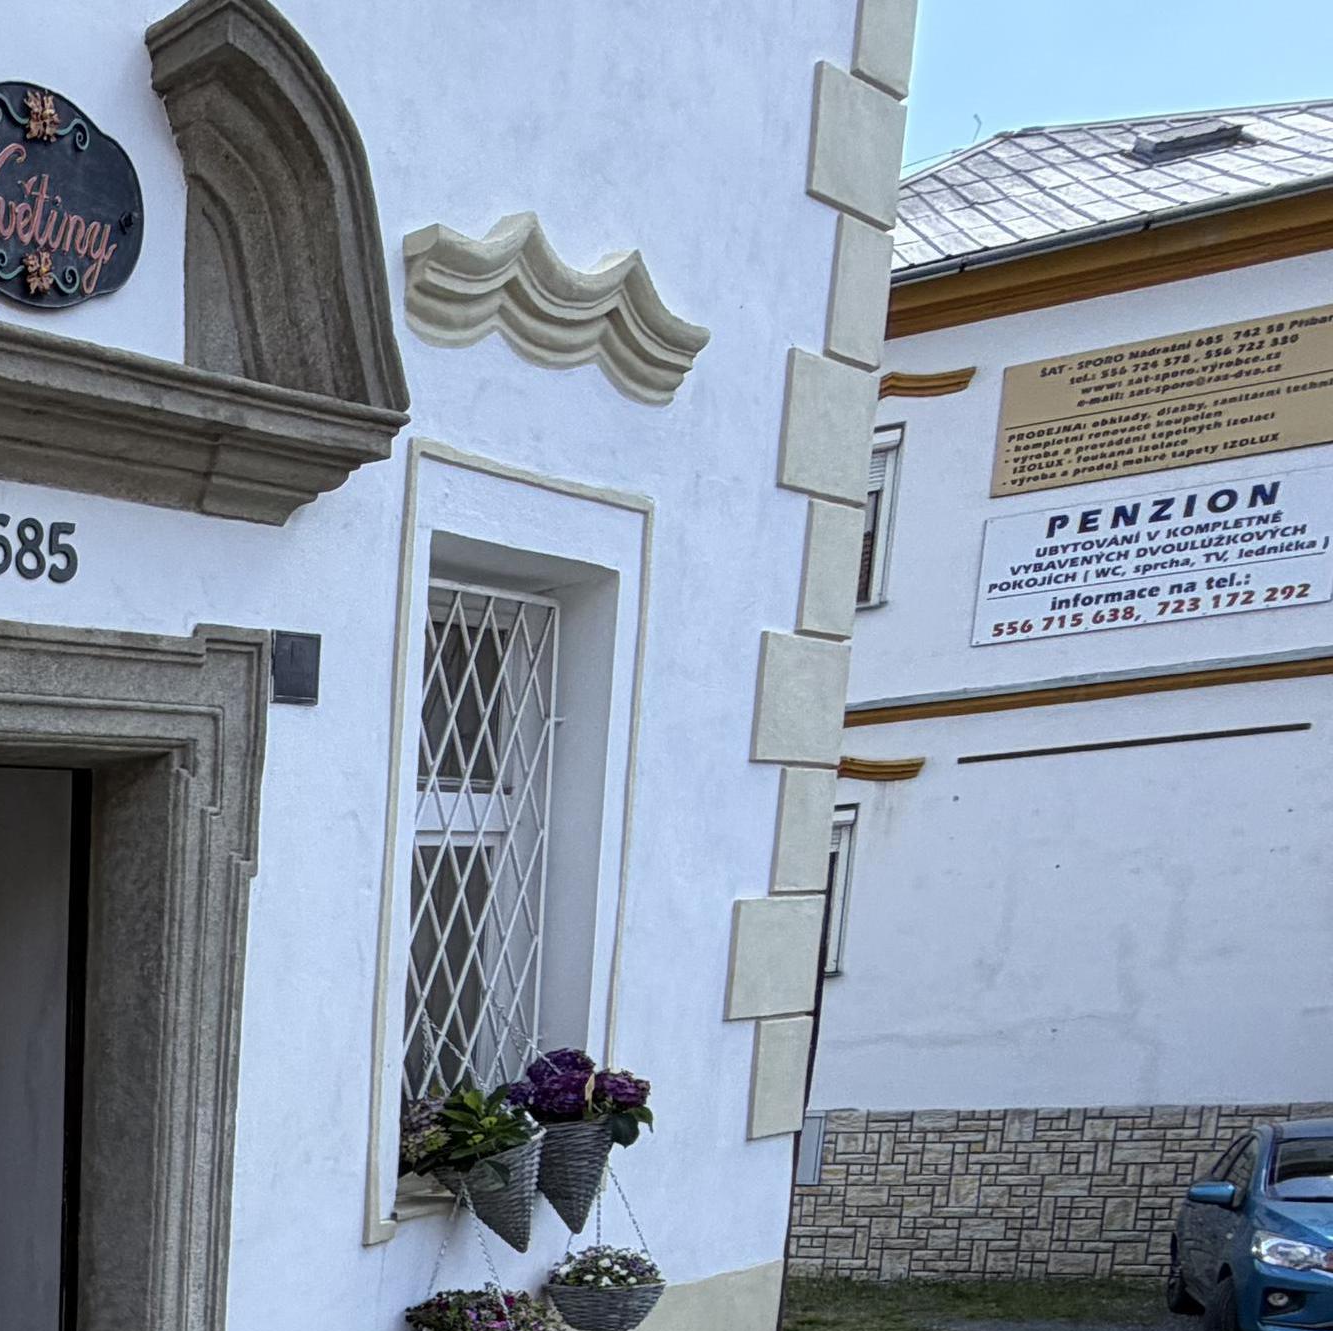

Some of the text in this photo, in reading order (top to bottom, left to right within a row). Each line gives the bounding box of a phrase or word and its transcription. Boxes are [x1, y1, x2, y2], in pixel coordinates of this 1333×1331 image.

[1076, 353, 1124, 370] SPORO
[1047, 482, 1279, 537] PENZION
[1010, 549, 1129, 575] VYBAVENÝCH
[1035, 531, 1140, 557] UBYTOVÁNÍ
[1146, 529, 1160, 541] V
[987, 571, 1077, 593] POKOJÍCH
[1094, 564, 1126, 578] WC,
[1132, 557, 1195, 575] sprcha,
[1202, 549, 1229, 563] TV,
[1237, 539, 1317, 559] lednička
[991, 582, 1311, 637] 556 715 638, 723 172 292
[1050, 572, 1251, 610] informace na tel.:
